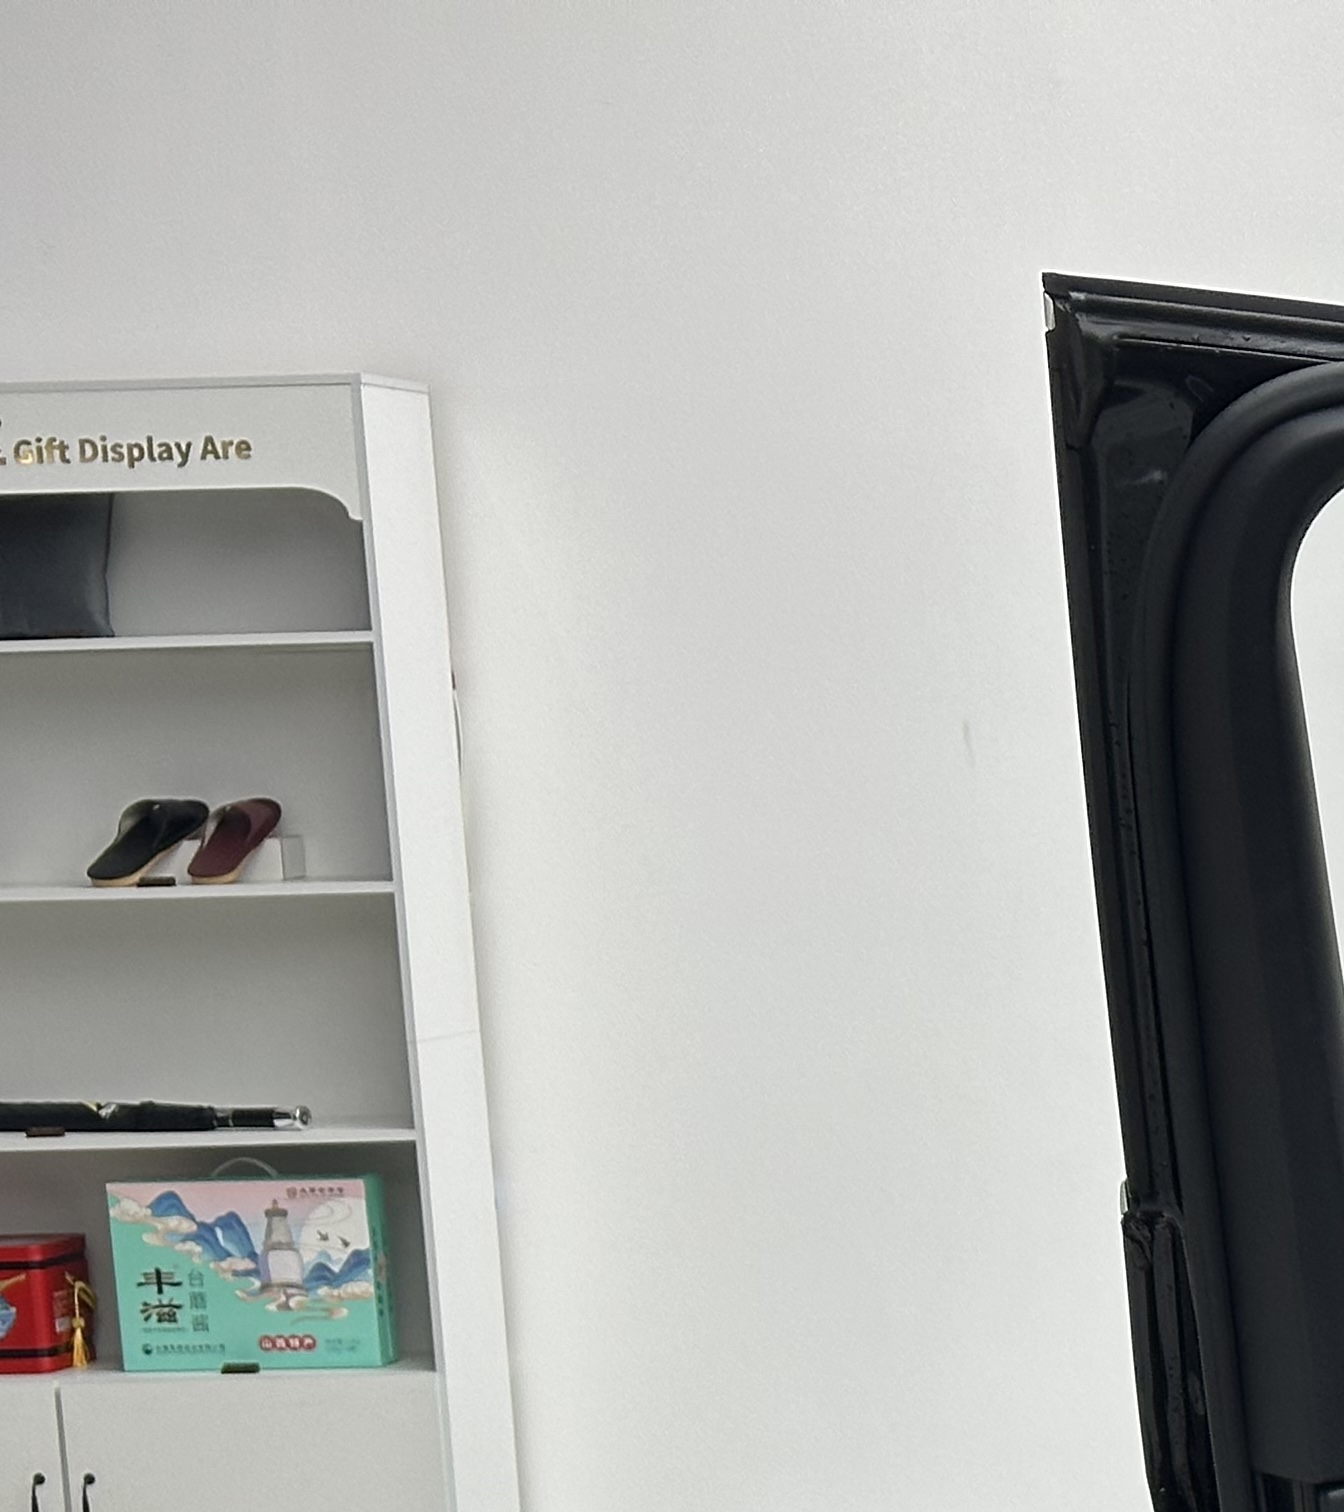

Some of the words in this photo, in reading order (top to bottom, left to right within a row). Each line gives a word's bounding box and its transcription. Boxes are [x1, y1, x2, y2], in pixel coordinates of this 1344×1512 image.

[13, 436, 71, 465] Gift
[78, 434, 193, 469] Display
[200, 435, 253, 461] Are
